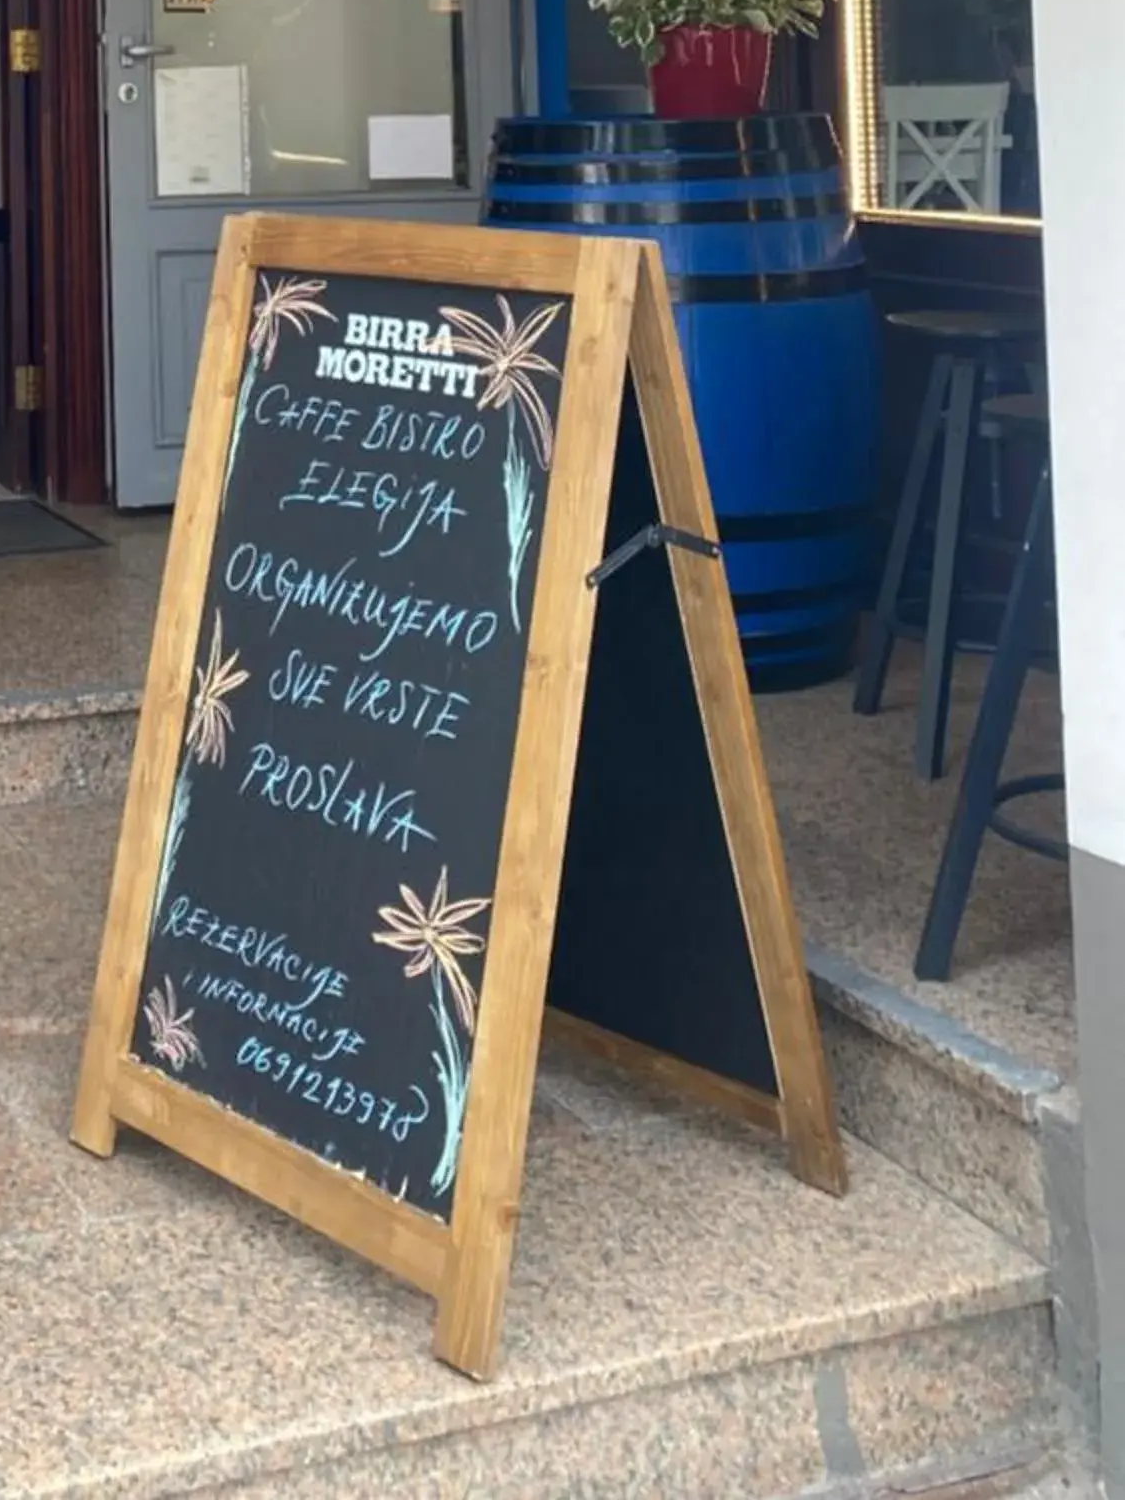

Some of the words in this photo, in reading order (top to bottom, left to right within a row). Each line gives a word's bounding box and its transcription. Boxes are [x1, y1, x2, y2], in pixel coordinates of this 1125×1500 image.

[315, 346, 477, 399] MORETTI
[344, 313, 456, 357] BIRRA
[253, 383, 362, 442] CAFFE
[361, 404, 486, 460] BISTRO
[268, 649, 339, 709] SVE
[343, 672, 471, 739] VRSTE
[238, 742, 438, 853] PROSLAVA
[161, 896, 351, 1011] REZERVACIJE
